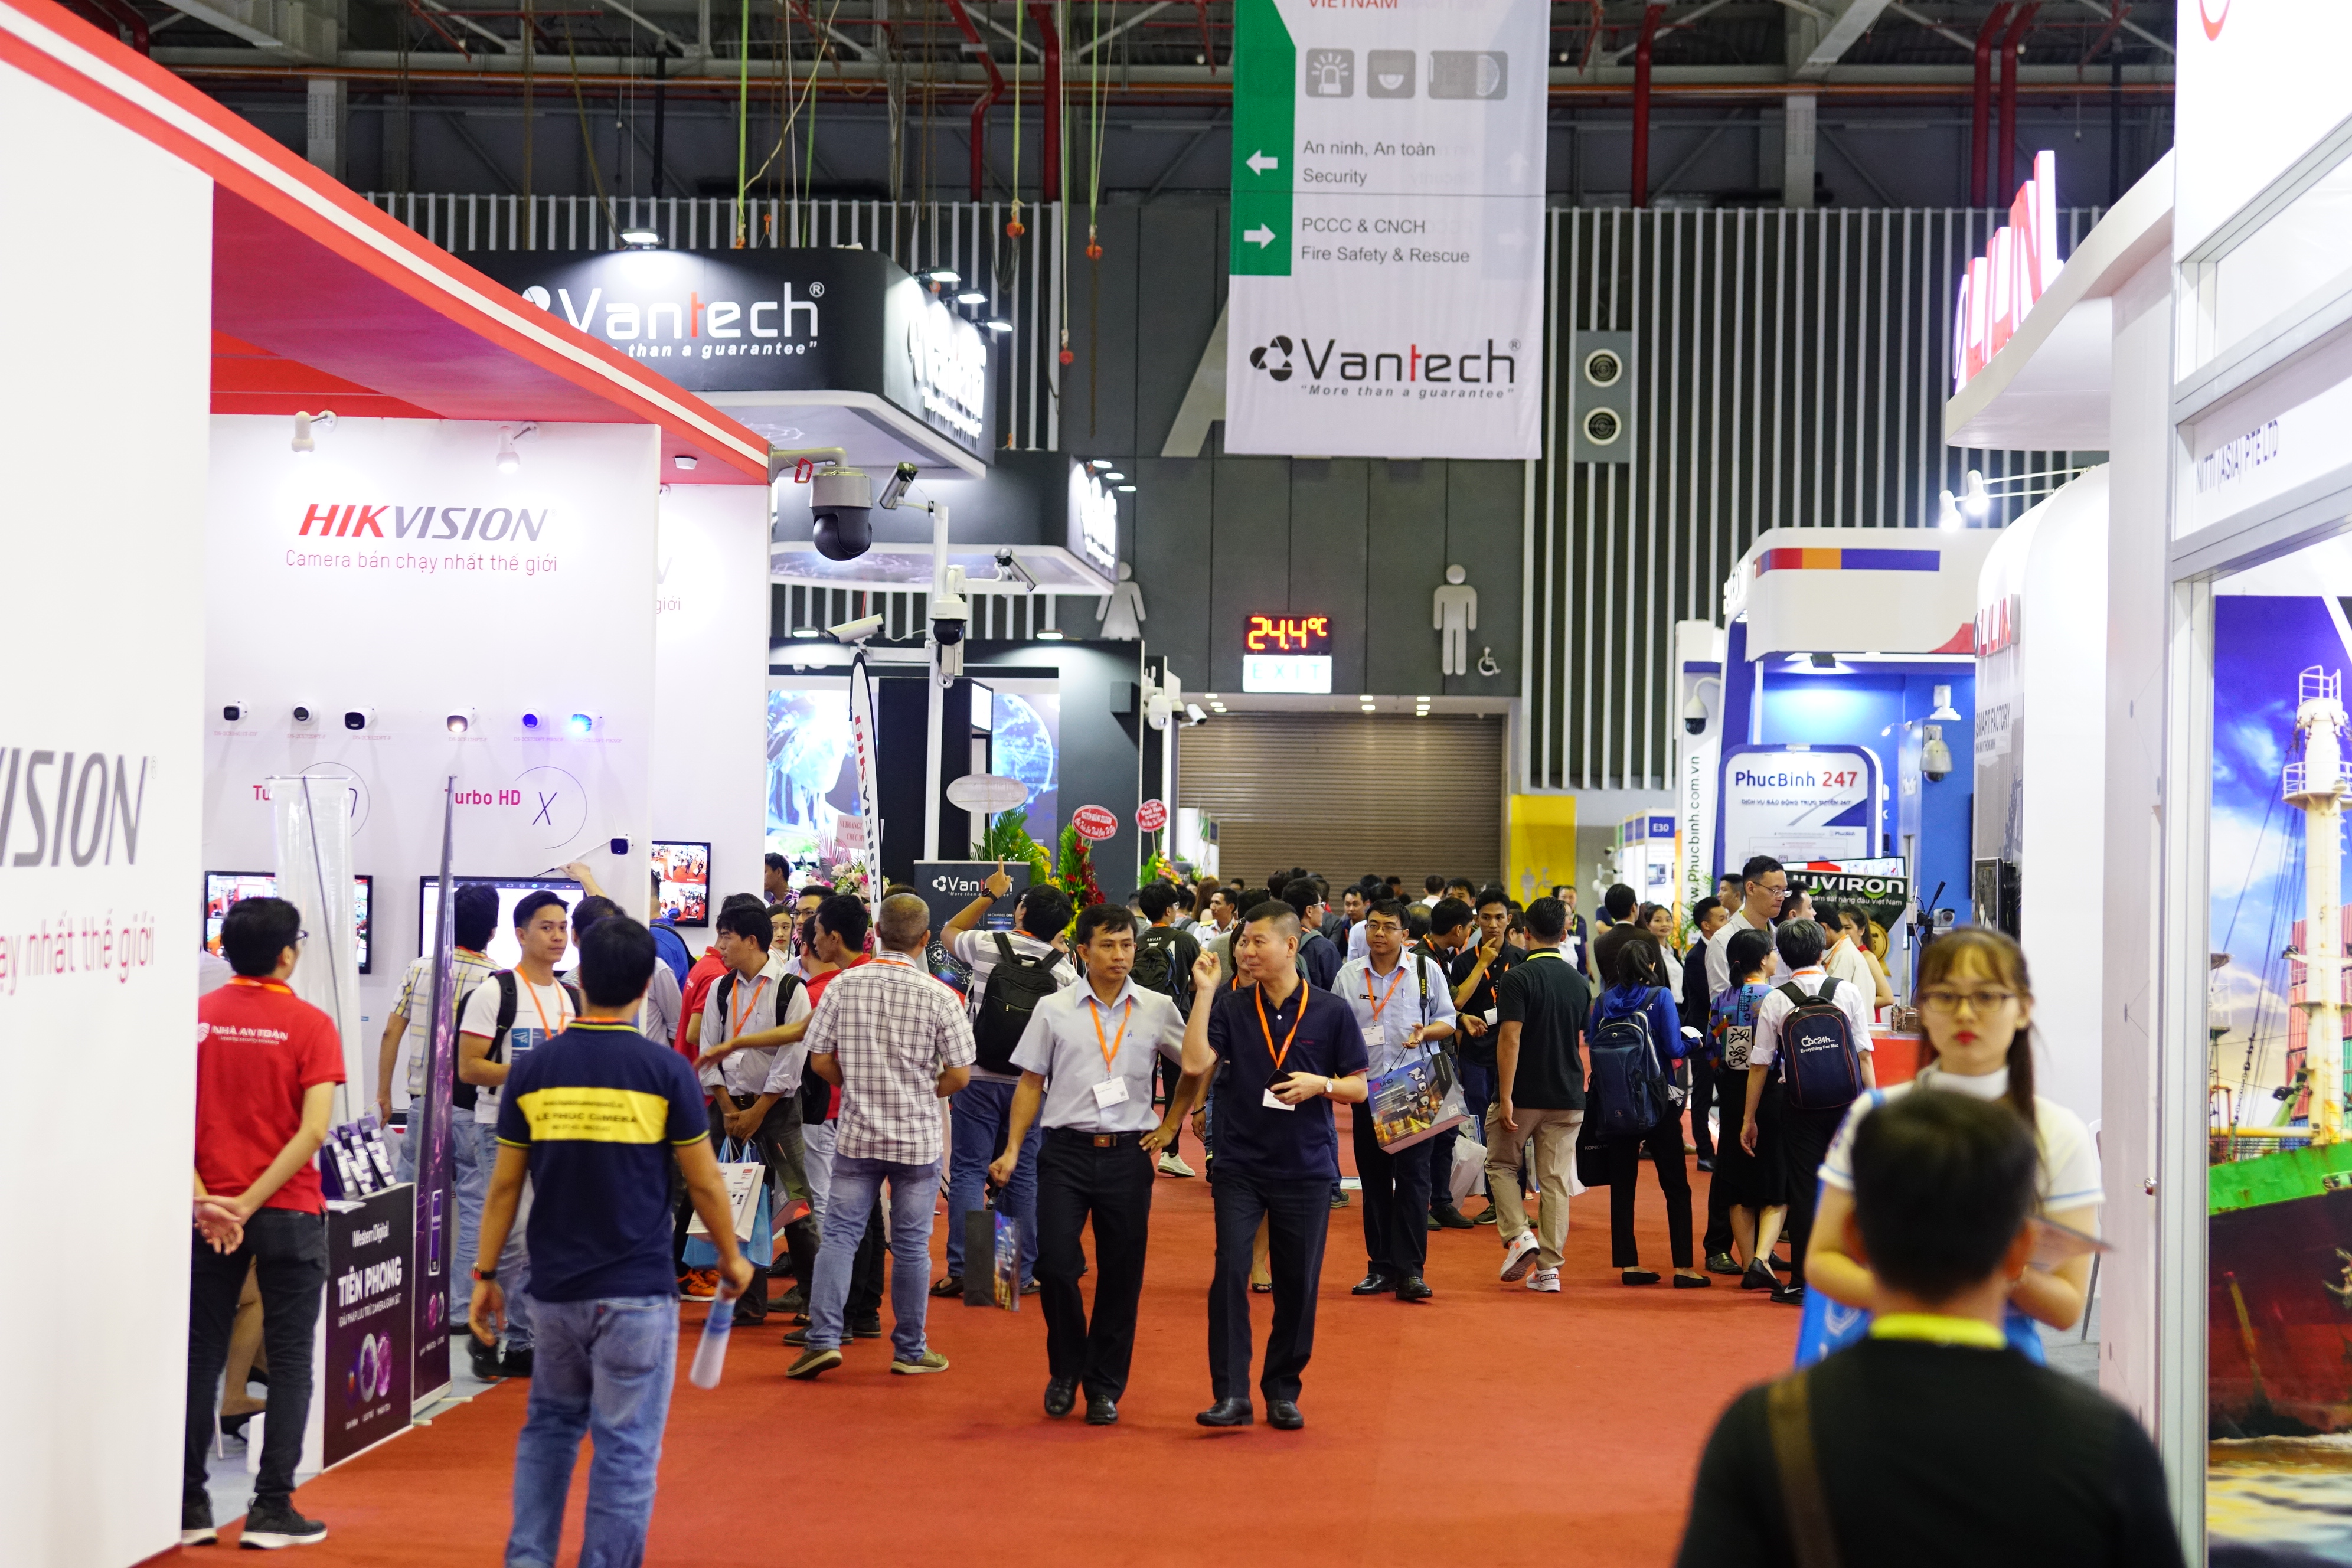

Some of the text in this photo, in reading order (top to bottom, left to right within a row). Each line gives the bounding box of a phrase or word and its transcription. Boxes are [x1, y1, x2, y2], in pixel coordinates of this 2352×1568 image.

[1304, 140, 1435, 157] An ninh, An toàn
[1303, 168, 1367, 187] Security
[1302, 217, 1426, 233] PCCC & CNCH
[1301, 246, 1470, 264] Fire Safety & Rescue
[558, 282, 818, 340] Vantech
[628, 342, 672, 357] than
[682, 344, 691, 357] a
[1301, 338, 1514, 383] Vantech
[1358, 386, 1393, 397] than
[298, 504, 548, 541] HIKVISION
[286, 550, 557, 576] Camera bán chạy nhất thế giới
[1253, 662, 1321, 679] EXIT
[1976, 703, 2010, 739] SMART FACTORY
[1736, 770, 1857, 787] PhucBinh 247
[0, 746, 149, 867] ISION
[499, 790, 521, 806] HD
[1653, 823, 1669, 832] E30
[948, 877, 1012, 892] Vant
[26, 910, 76, 976] nhất
[82, 908, 113, 971] thế
[118, 910, 155, 984] giới
[212, 1025, 288, 1040] NHÀ AN TOÀN
[352, 1220, 390, 1248] Western Digital
[338, 1256, 403, 1308] TIÊN PHONG
